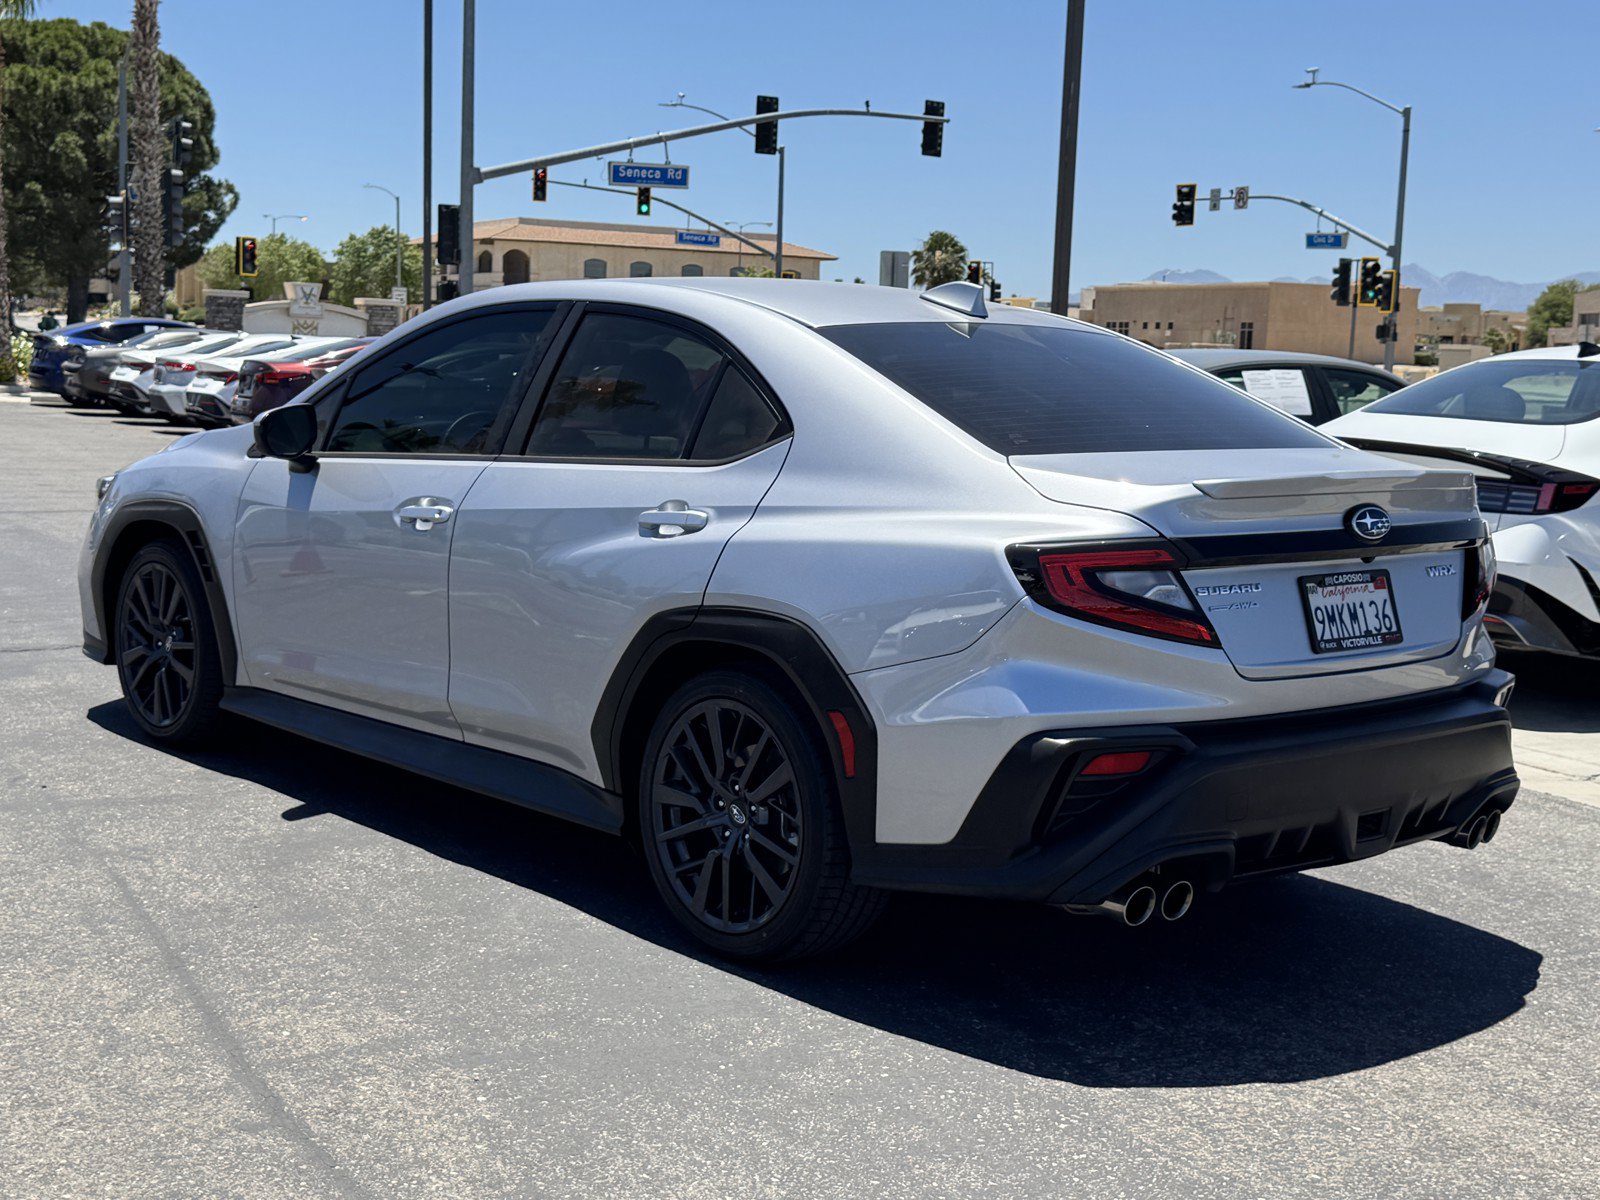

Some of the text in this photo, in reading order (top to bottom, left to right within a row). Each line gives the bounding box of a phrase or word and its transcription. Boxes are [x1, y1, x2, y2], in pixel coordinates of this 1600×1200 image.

[619, 166, 682, 180] Seneca Rd
[683, 233, 717, 243] Seneca Rd
[1426, 565, 1456, 577] WRX
[1333, 573, 1363, 584] CAPOSIO
[1195, 582, 1262, 597] SUBARU
[1321, 584, 1374, 602] California
[1314, 598, 1394, 640] 9MKM136
[1341, 635, 1383, 649] VICTORVILLE
